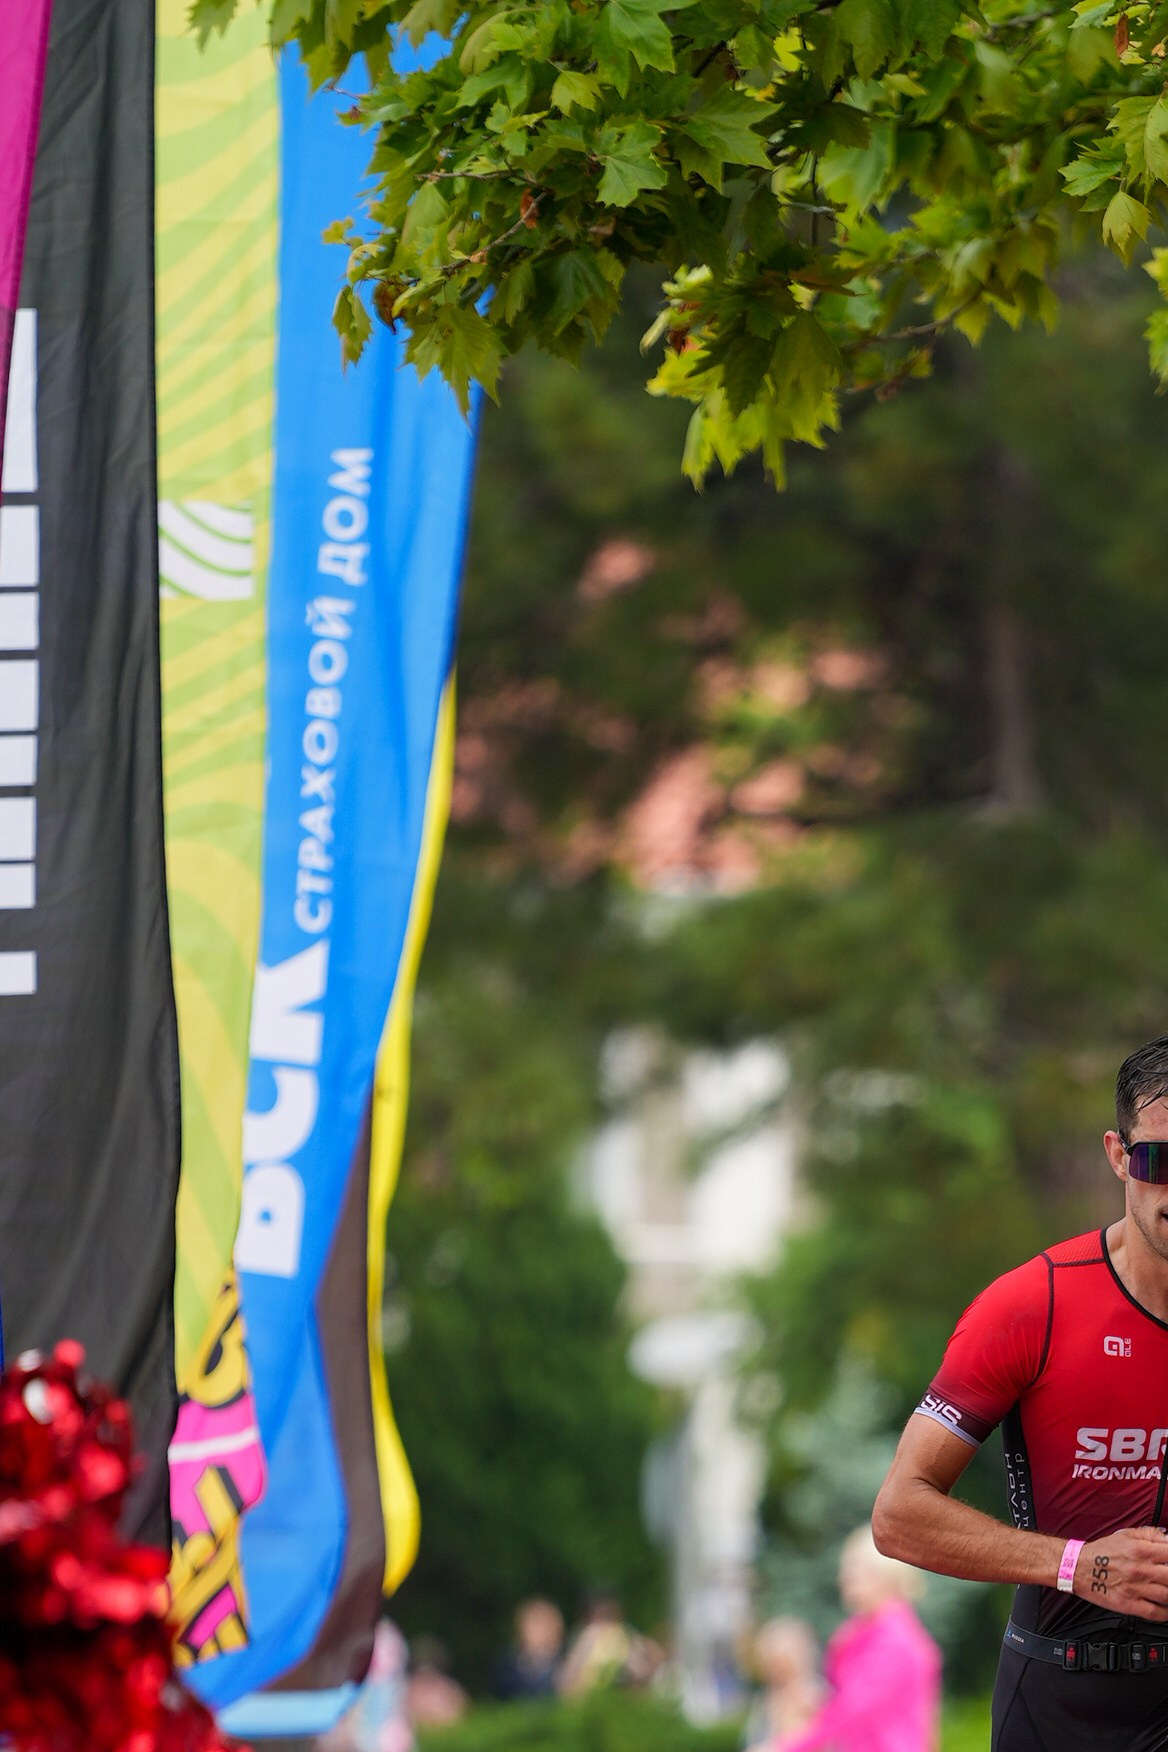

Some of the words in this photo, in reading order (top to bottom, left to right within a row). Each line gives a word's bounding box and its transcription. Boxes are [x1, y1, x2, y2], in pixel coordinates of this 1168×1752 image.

[317, 447, 374, 588] ДОМ
[294, 595, 356, 935] СТРАХОВОЙ
[1091, 1555, 1110, 1595] 358
